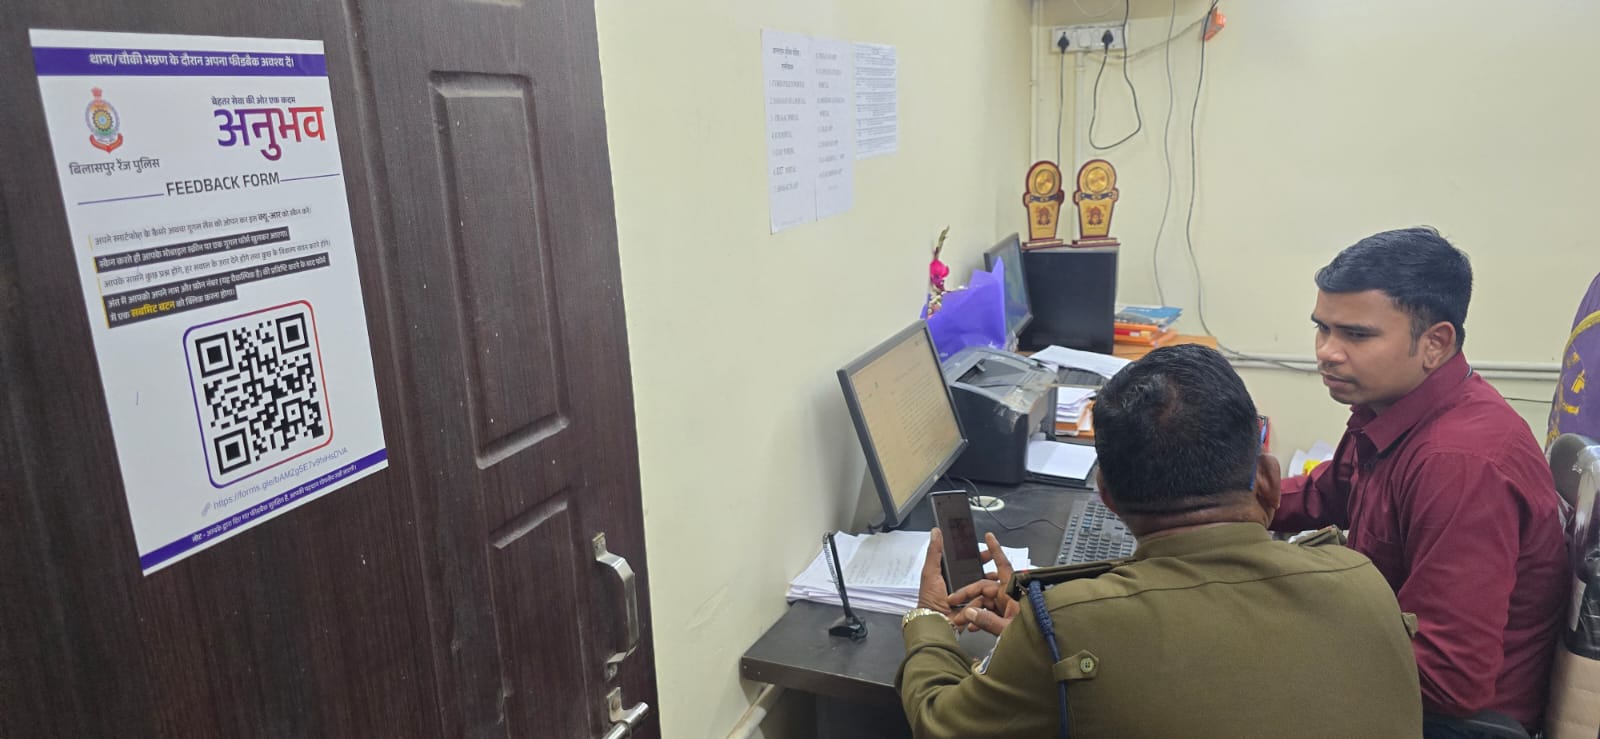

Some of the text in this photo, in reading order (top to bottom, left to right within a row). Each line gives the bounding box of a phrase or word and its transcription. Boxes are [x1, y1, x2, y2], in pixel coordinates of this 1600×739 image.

[90, 51, 143, 65] थाना/चौकी
[169, 52, 179, 65] के
[180, 53, 203, 66] दौरान
[204, 56, 228, 66] अपना
[228, 54, 260, 66] फीडबैक
[261, 57, 284, 67] अवश्य
[211, 96, 230, 106] बेहतर
[231, 95, 245, 105] सेवा
[245, 95, 255, 104] की
[256, 95, 268, 104] ओर
[281, 96, 296, 104] कदम
[213, 105, 325, 161] अनुभव
[69, 156, 160, 176] बिलासपुर रेंज पुलिस
[166, 172, 280, 195] FEEDBACK FORM
[130, 304, 158, 317] सबमिट
[158, 300, 175, 311] बटन
